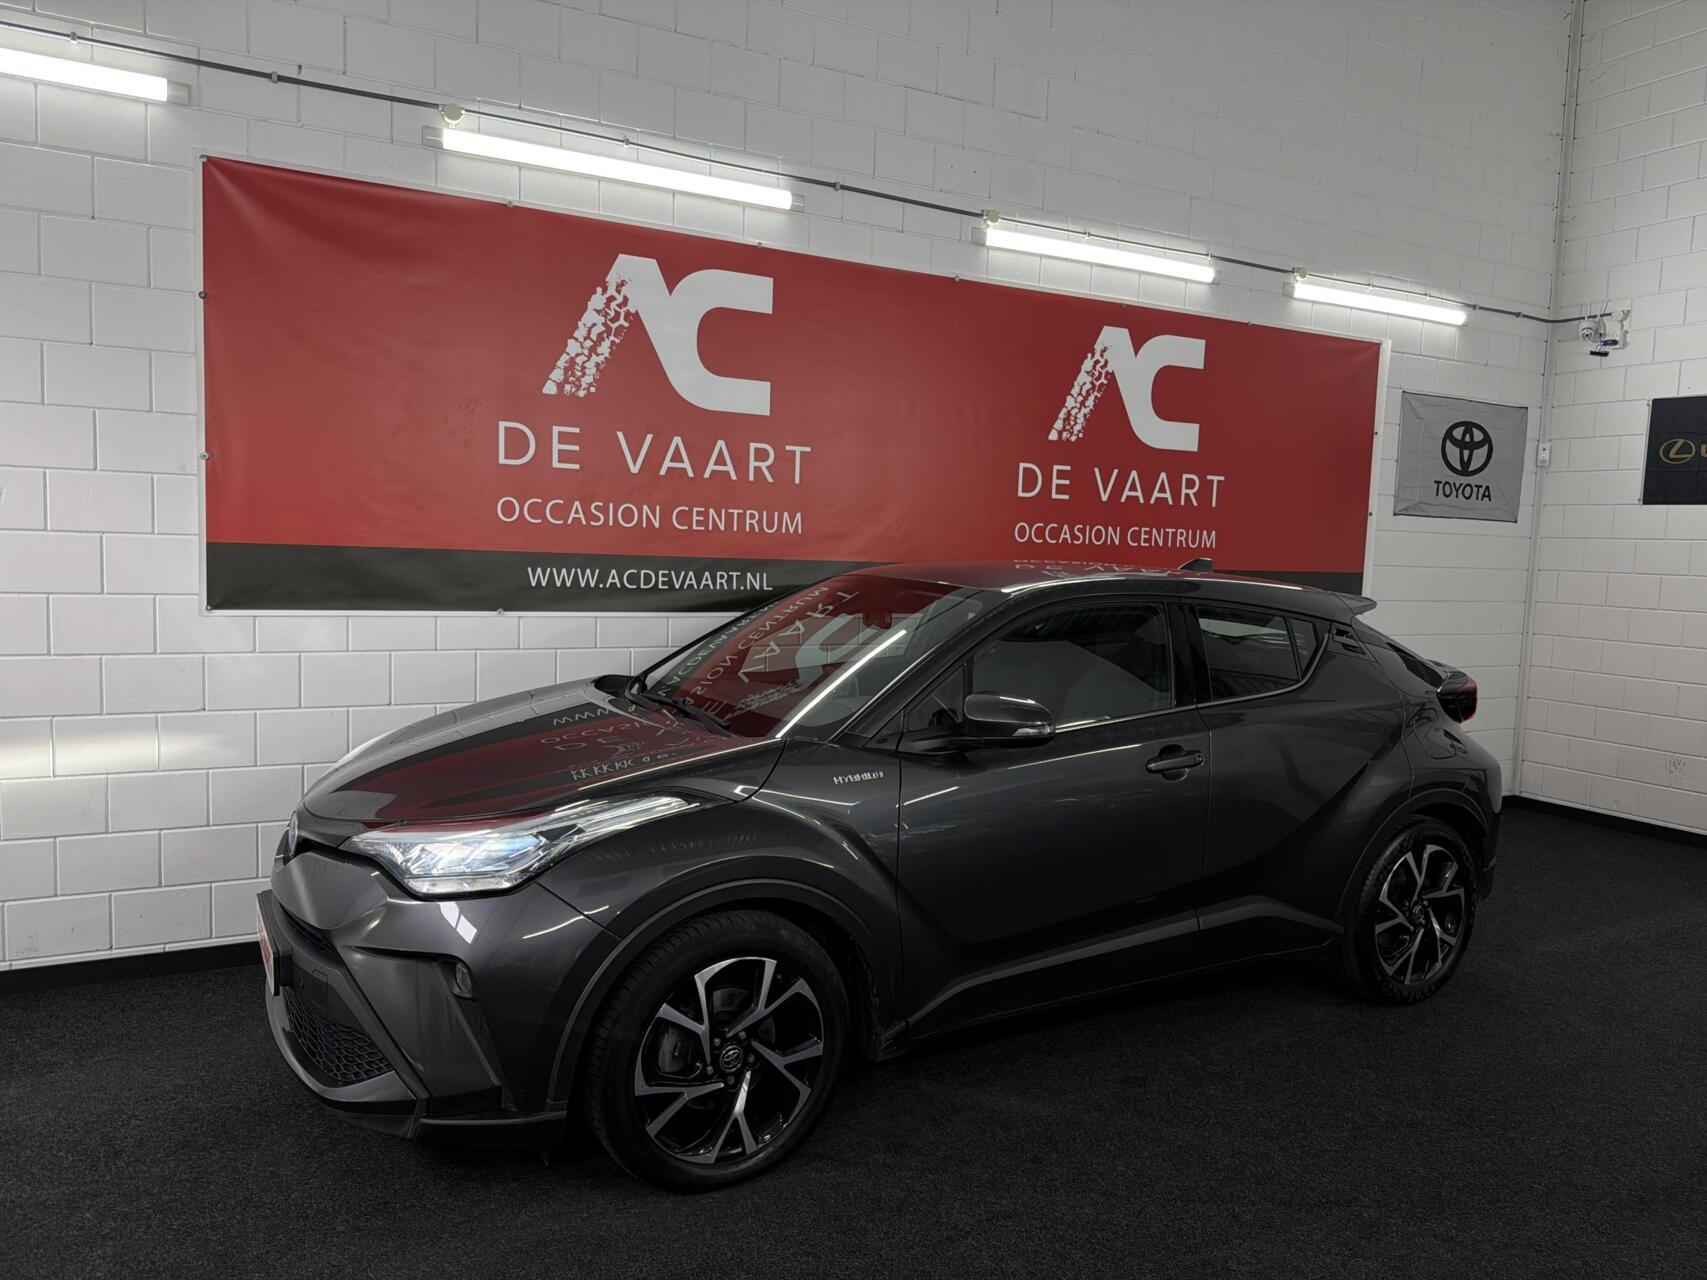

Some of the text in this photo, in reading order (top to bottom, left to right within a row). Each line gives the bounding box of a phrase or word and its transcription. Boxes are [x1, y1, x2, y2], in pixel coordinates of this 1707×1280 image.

[542, 253, 774, 417] AC
[1048, 325, 1206, 452] AC
[497, 420, 812, 485] DE VAART
[1017, 462, 1225, 508] DE VAART
[1433, 480, 1492, 502] TOYOTA
[496, 496, 802, 534] OCCASION CENTRUM
[1014, 522, 1216, 548] OCCASION CENTRUM
[527, 566, 773, 591] WWW.ACDEVAART.NL
